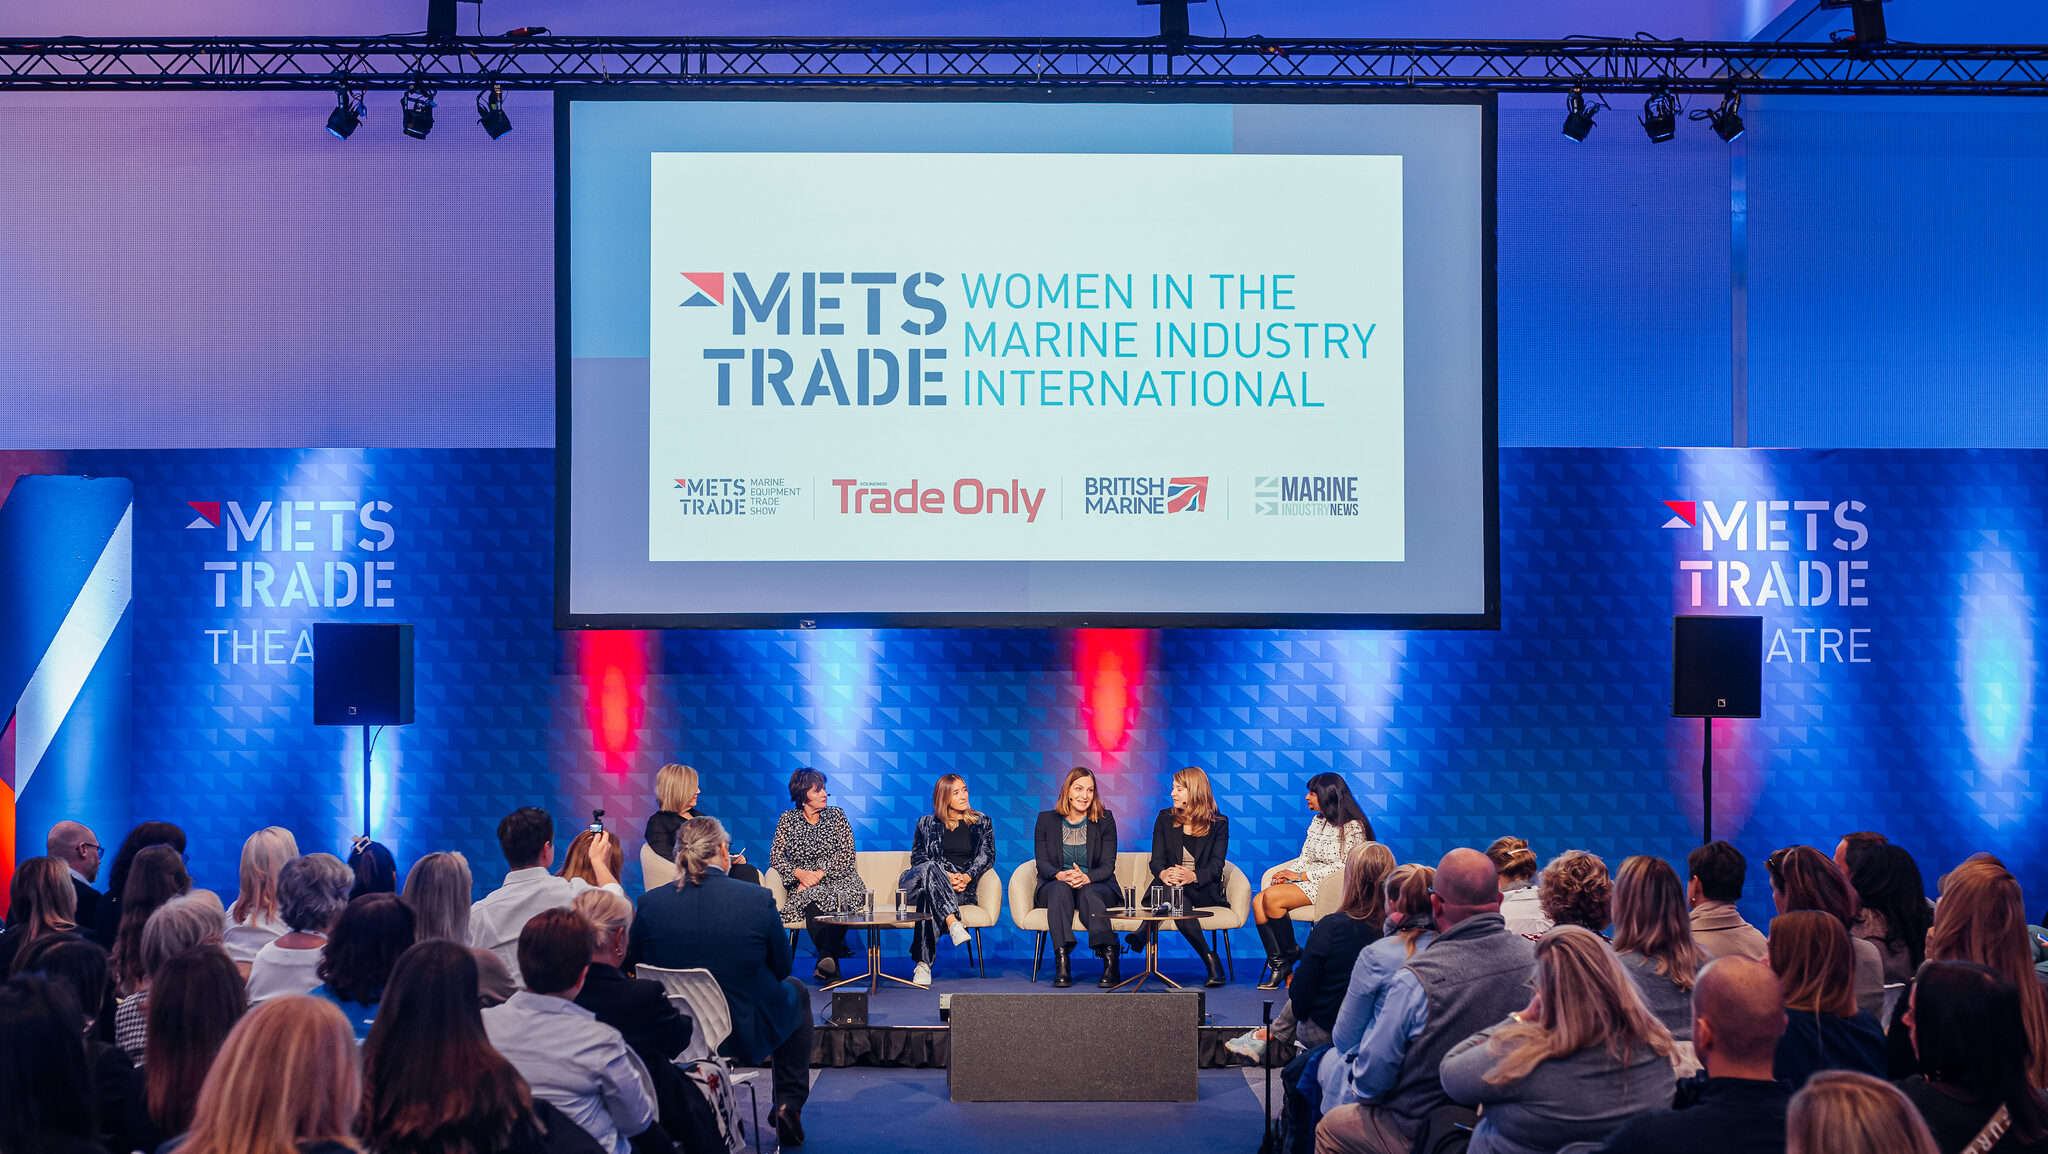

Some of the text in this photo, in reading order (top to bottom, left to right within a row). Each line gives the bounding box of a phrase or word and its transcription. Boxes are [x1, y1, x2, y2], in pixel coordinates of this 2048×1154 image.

[732, 272, 947, 336] METS
[962, 272, 1296, 311] WOMEN IN THE
[964, 321, 1377, 359] MARINE INDUSTRY
[703, 348, 947, 407] TRADE
[964, 370, 1325, 408] INTERNATIONAL
[687, 478, 746, 496] METS
[750, 478, 785, 487] MARINE
[750, 487, 801, 497] EQUIPMENT
[750, 497, 780, 506] TRADE
[832, 478, 1047, 523] Trade Only
[1085, 477, 1165, 496] BRITISH
[1281, 475, 1359, 502] MARINE
[679, 498, 746, 515] TRADE
[750, 507, 777, 516] SHOW
[1085, 496, 1165, 515] MARINE
[226, 500, 395, 552] METS
[1702, 500, 1869, 551] METS
[204, 561, 395, 608] TRADE
[1680, 560, 1869, 607] TRADE
